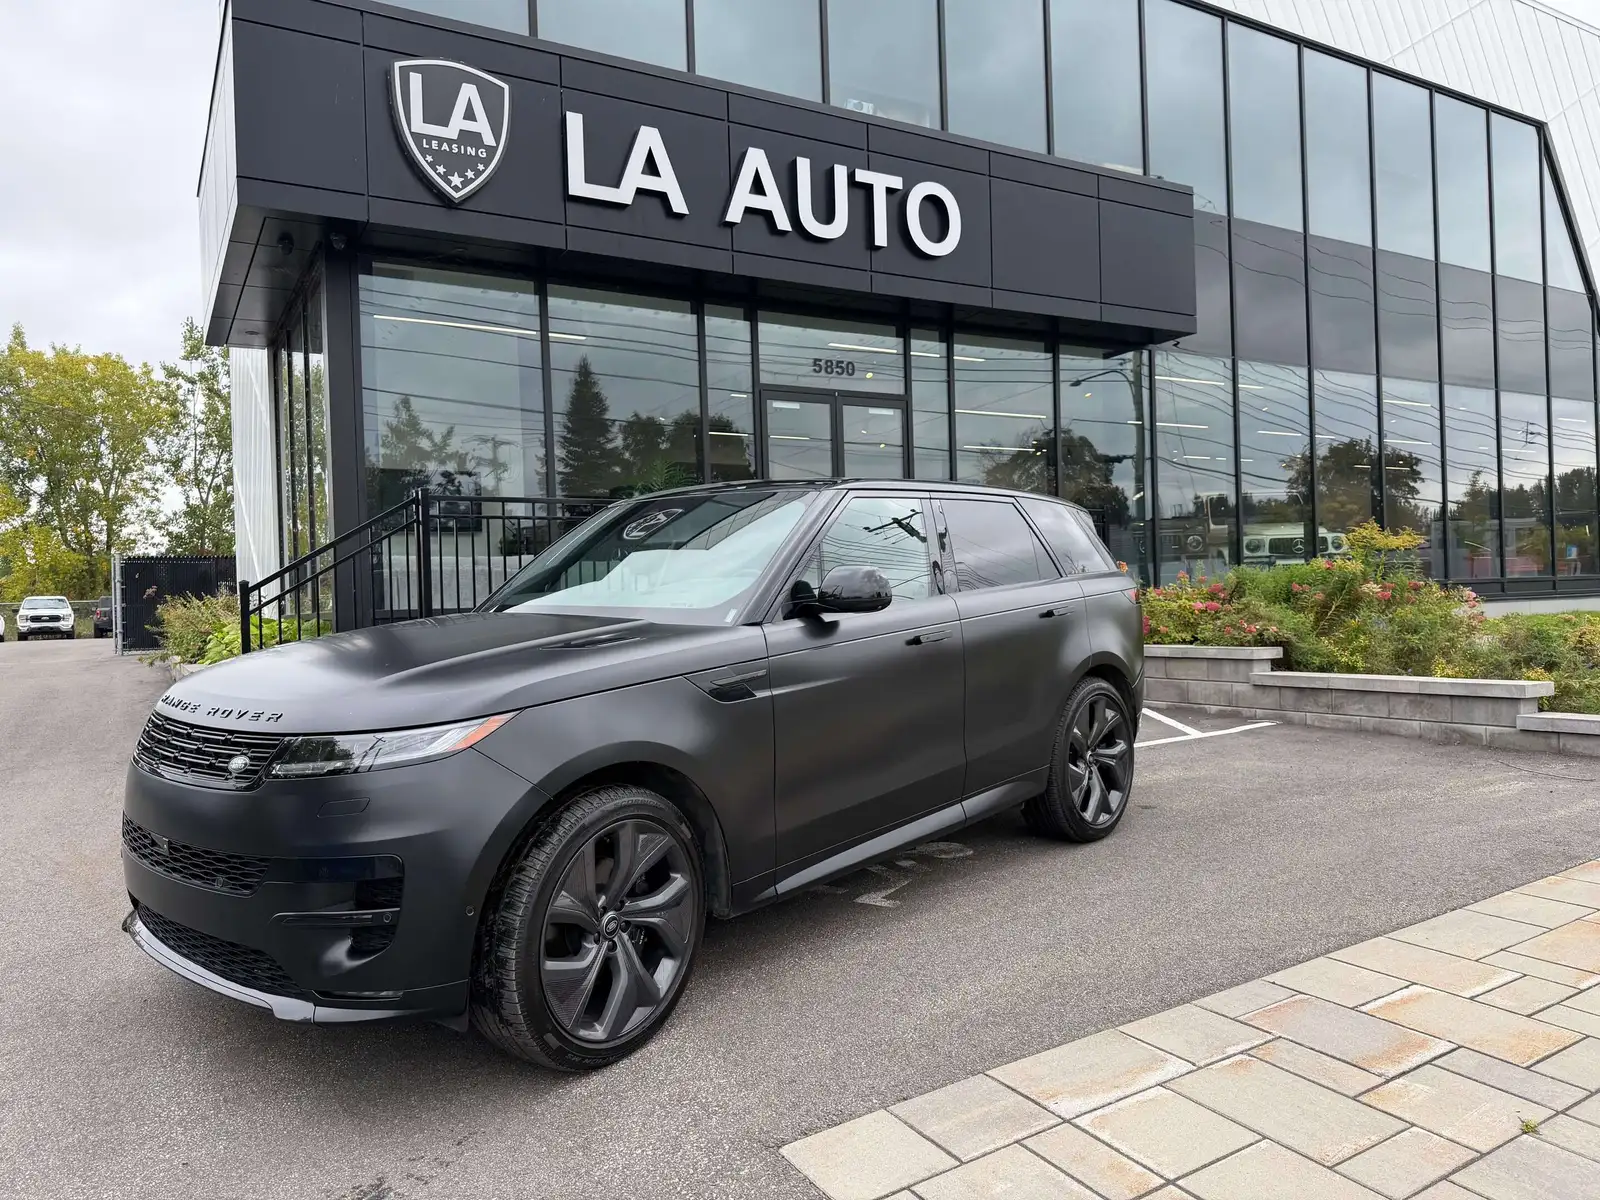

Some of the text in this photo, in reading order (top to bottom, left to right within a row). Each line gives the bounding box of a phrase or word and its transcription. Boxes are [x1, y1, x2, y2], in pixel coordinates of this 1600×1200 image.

[409, 72, 497, 147] LA
[422, 138, 487, 158] LEASING
[566, 111, 962, 257] LA AUTO
[812, 358, 856, 377] 5850
[161, 694, 283, 723] RANGE ROVER
